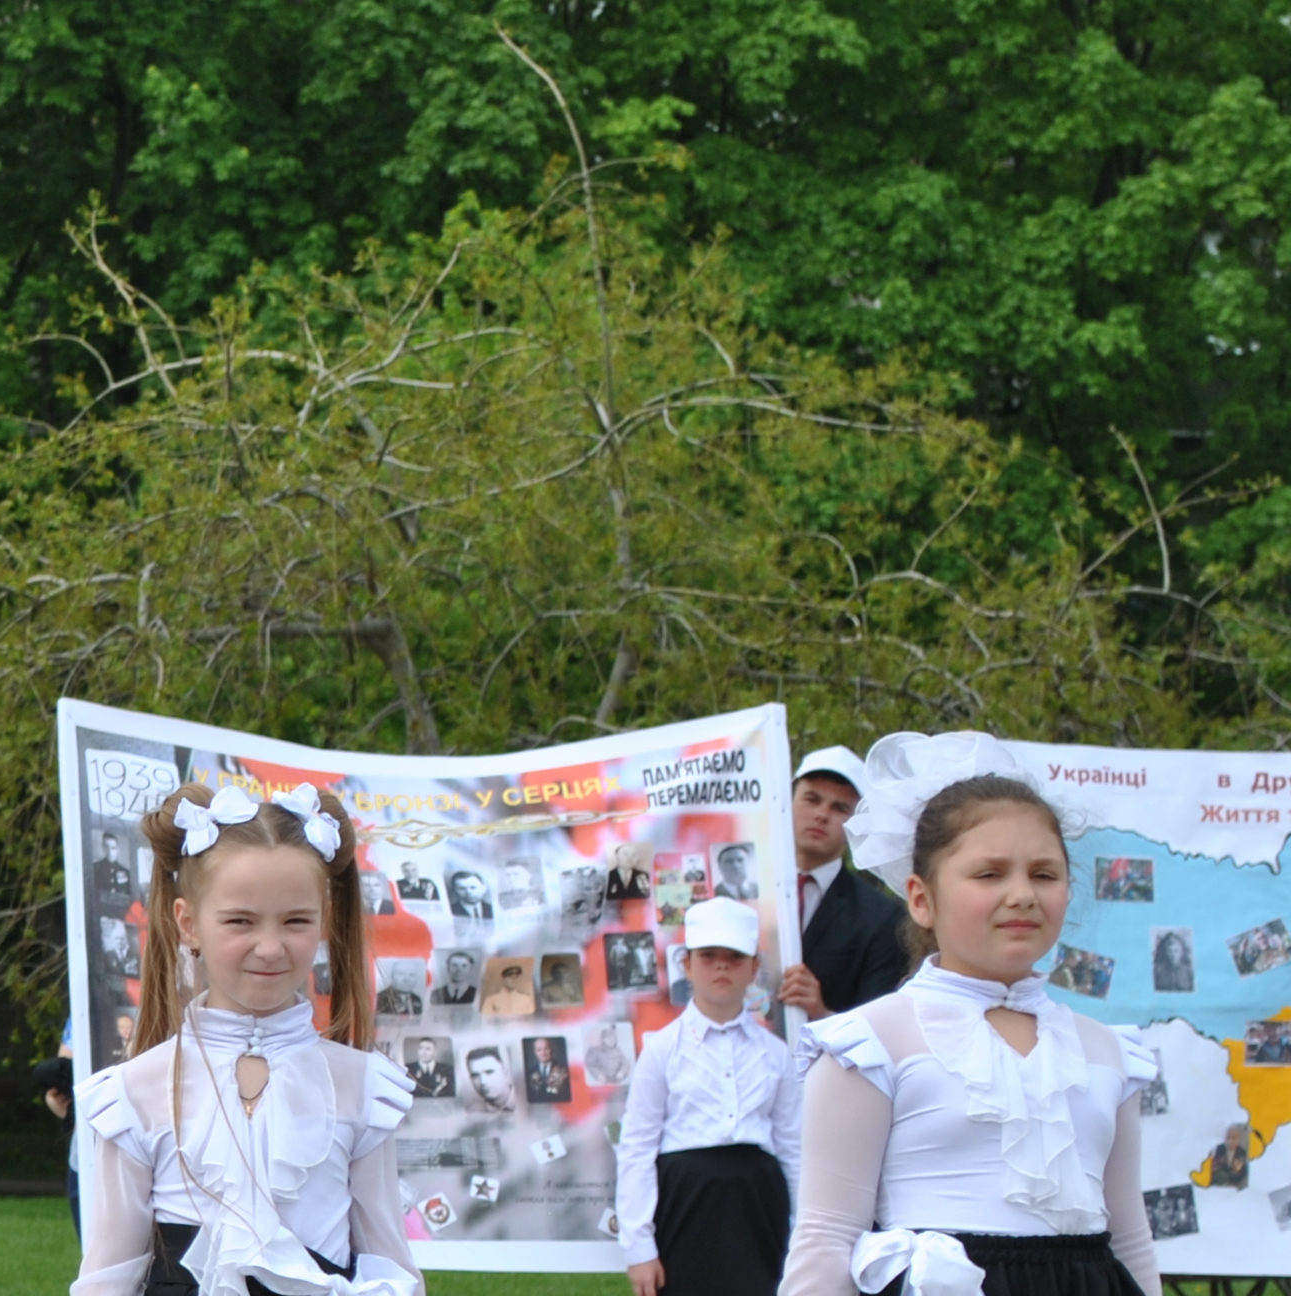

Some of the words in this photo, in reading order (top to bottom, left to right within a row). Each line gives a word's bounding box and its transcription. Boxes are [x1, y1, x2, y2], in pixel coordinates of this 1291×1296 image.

[89, 758, 176, 798] 1939
[216, 772, 302, 802] ГРАНІ
[354, 791, 469, 813] БРОНЗІ,
[475, 789, 494, 809] У
[501, 775, 623, 807] СЕРЦЯХ
[645, 779, 762, 808] ПЕРЕМАГАЄМО
[1047, 763, 1148, 790] Українці
[1217, 773, 1232, 789] в
[1250, 771, 1291, 795] Др
[1199, 804, 1281, 824] Життя
